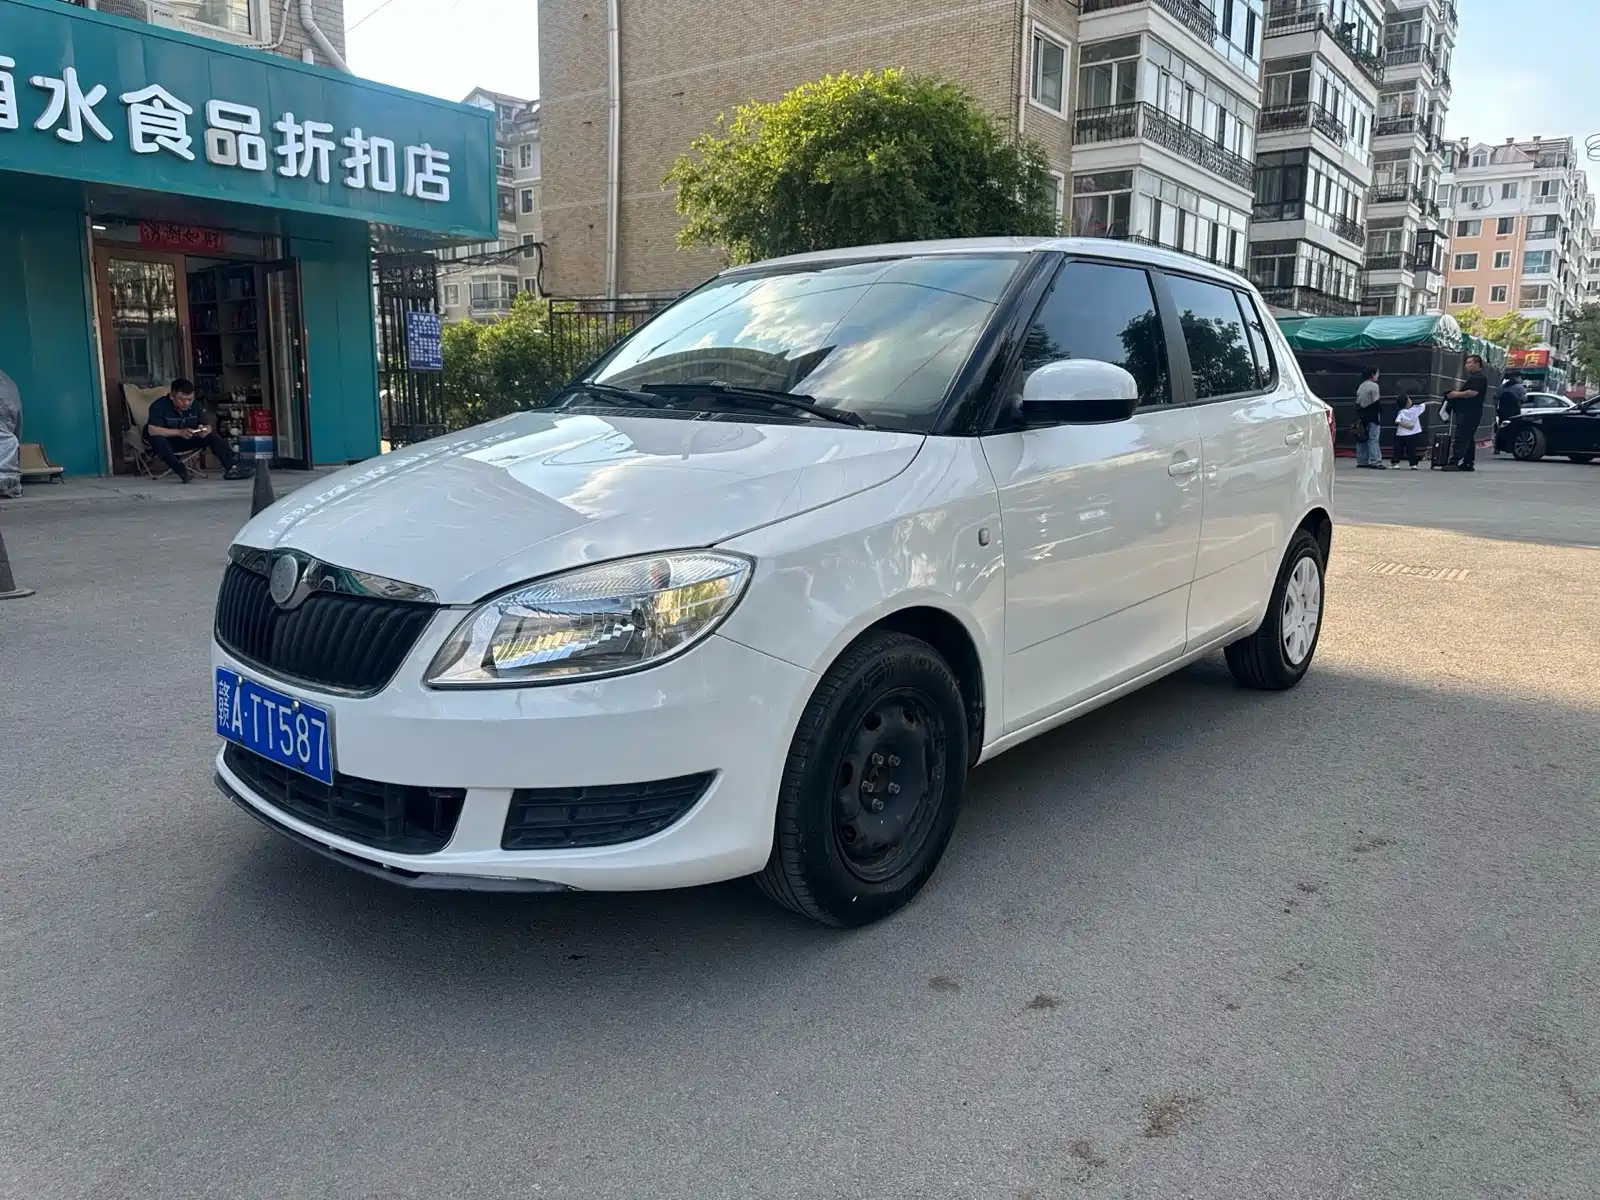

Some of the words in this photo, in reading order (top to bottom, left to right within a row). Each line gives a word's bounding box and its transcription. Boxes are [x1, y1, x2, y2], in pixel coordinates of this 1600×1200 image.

[0, 55, 451, 202] 水食品折扣店
